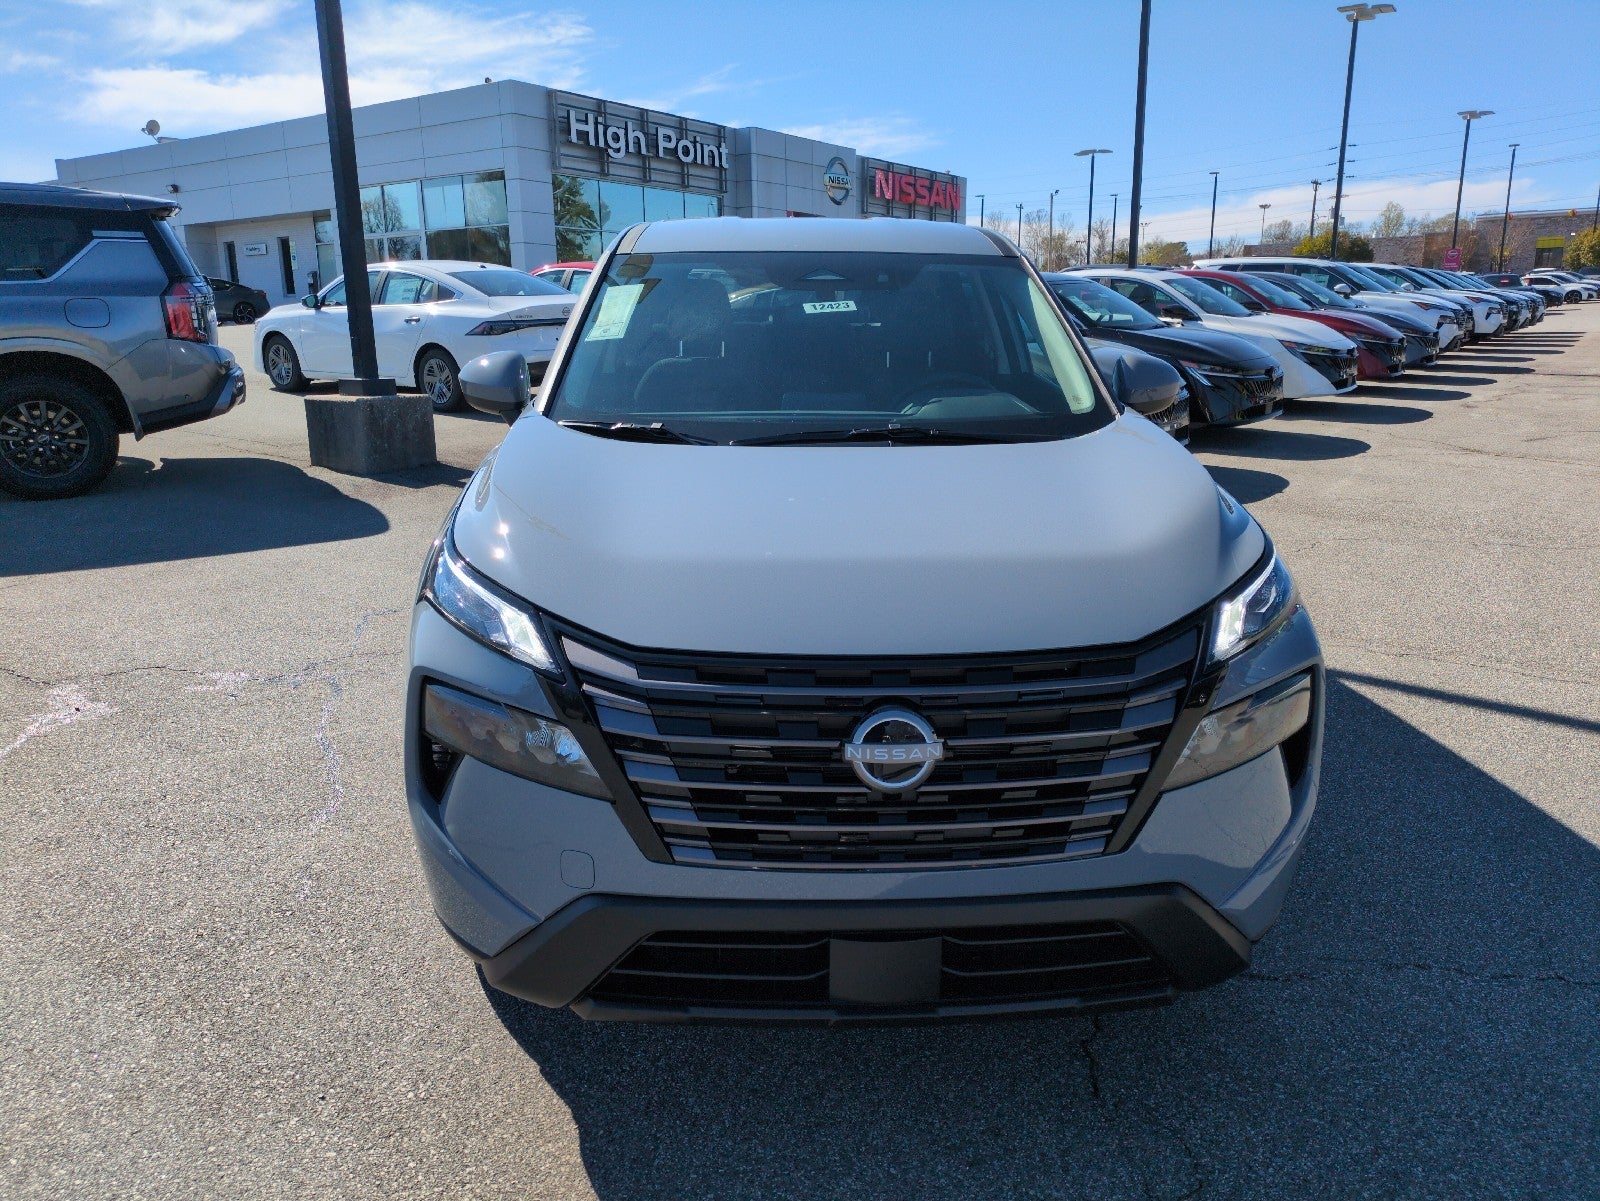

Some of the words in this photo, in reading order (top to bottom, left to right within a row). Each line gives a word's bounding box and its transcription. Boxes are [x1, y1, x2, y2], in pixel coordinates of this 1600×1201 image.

[567, 110, 646, 159] High
[657, 126, 729, 169] Point
[875, 169, 960, 210] NISSAN
[811, 302, 850, 311] 12423
[847, 746, 940, 760] NISSAN
